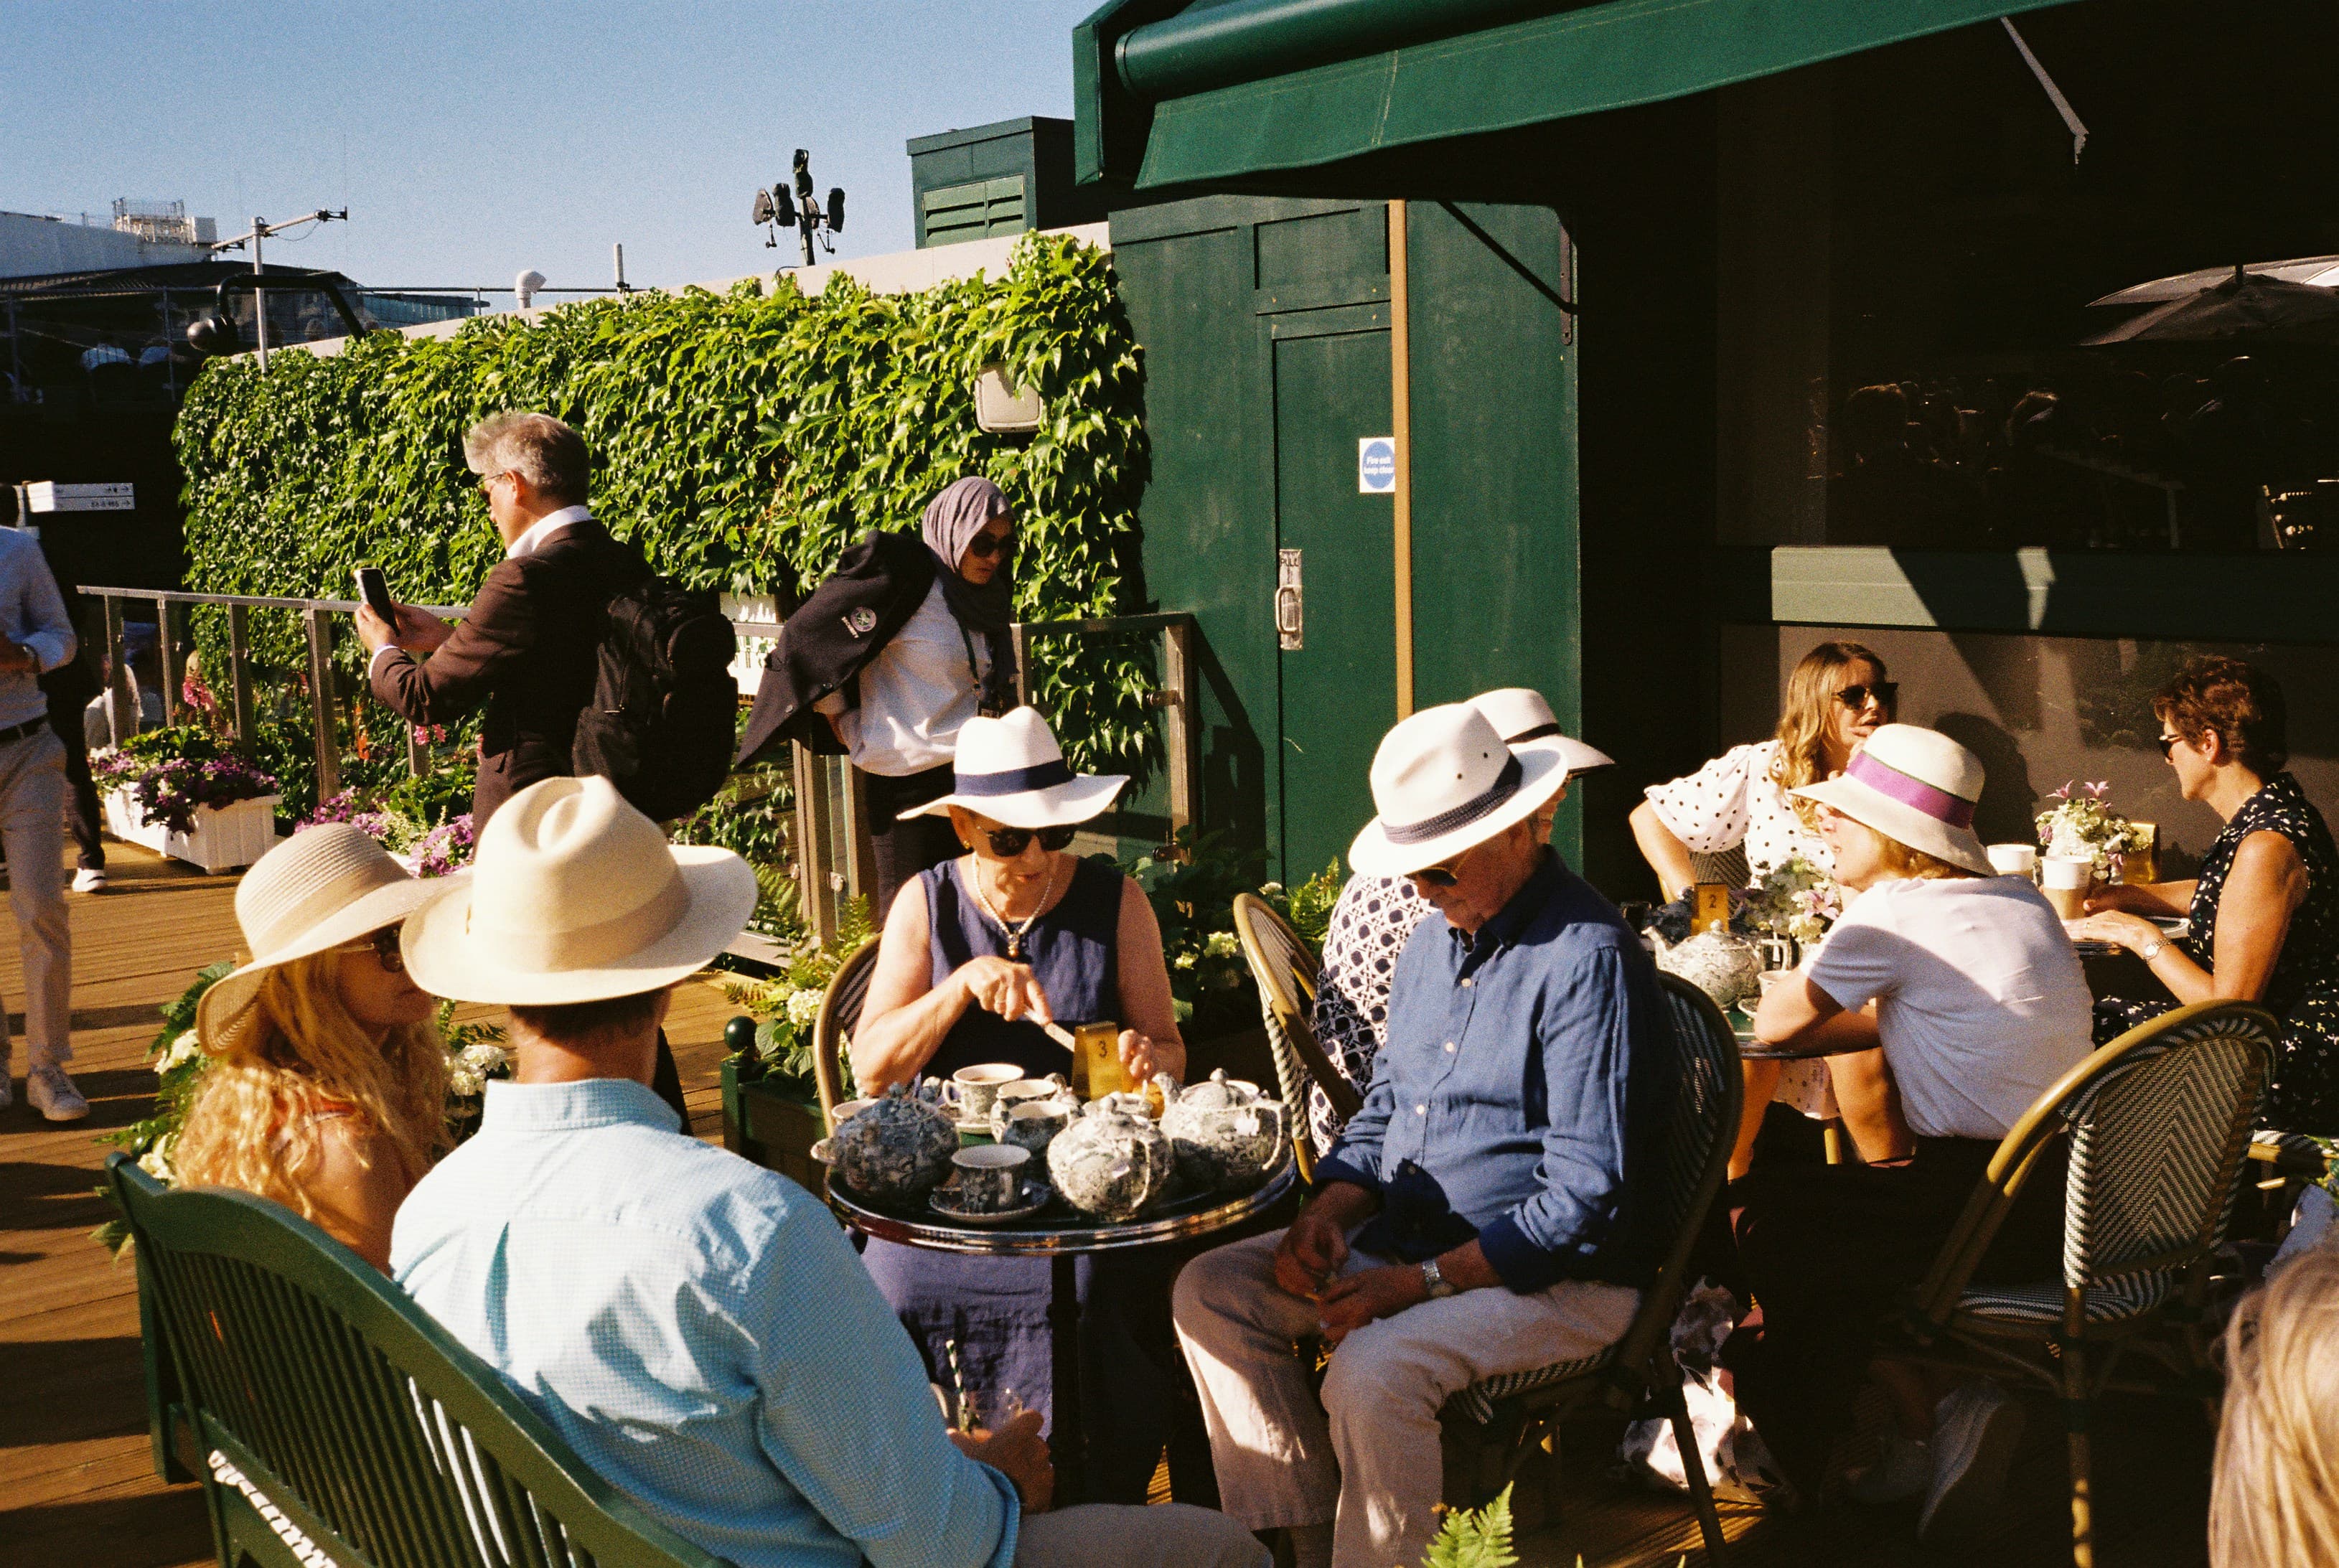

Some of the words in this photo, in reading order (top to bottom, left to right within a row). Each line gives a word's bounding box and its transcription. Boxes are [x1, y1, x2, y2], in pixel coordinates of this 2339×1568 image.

[1367, 456, 1379, 465] Fire
[1379, 456, 1391, 465] exit
[1364, 466, 1378, 476] keep
[1280, 558, 1300, 567] PULL
[1709, 894, 1717, 909] 2
[1098, 1040, 1108, 1058] 3
